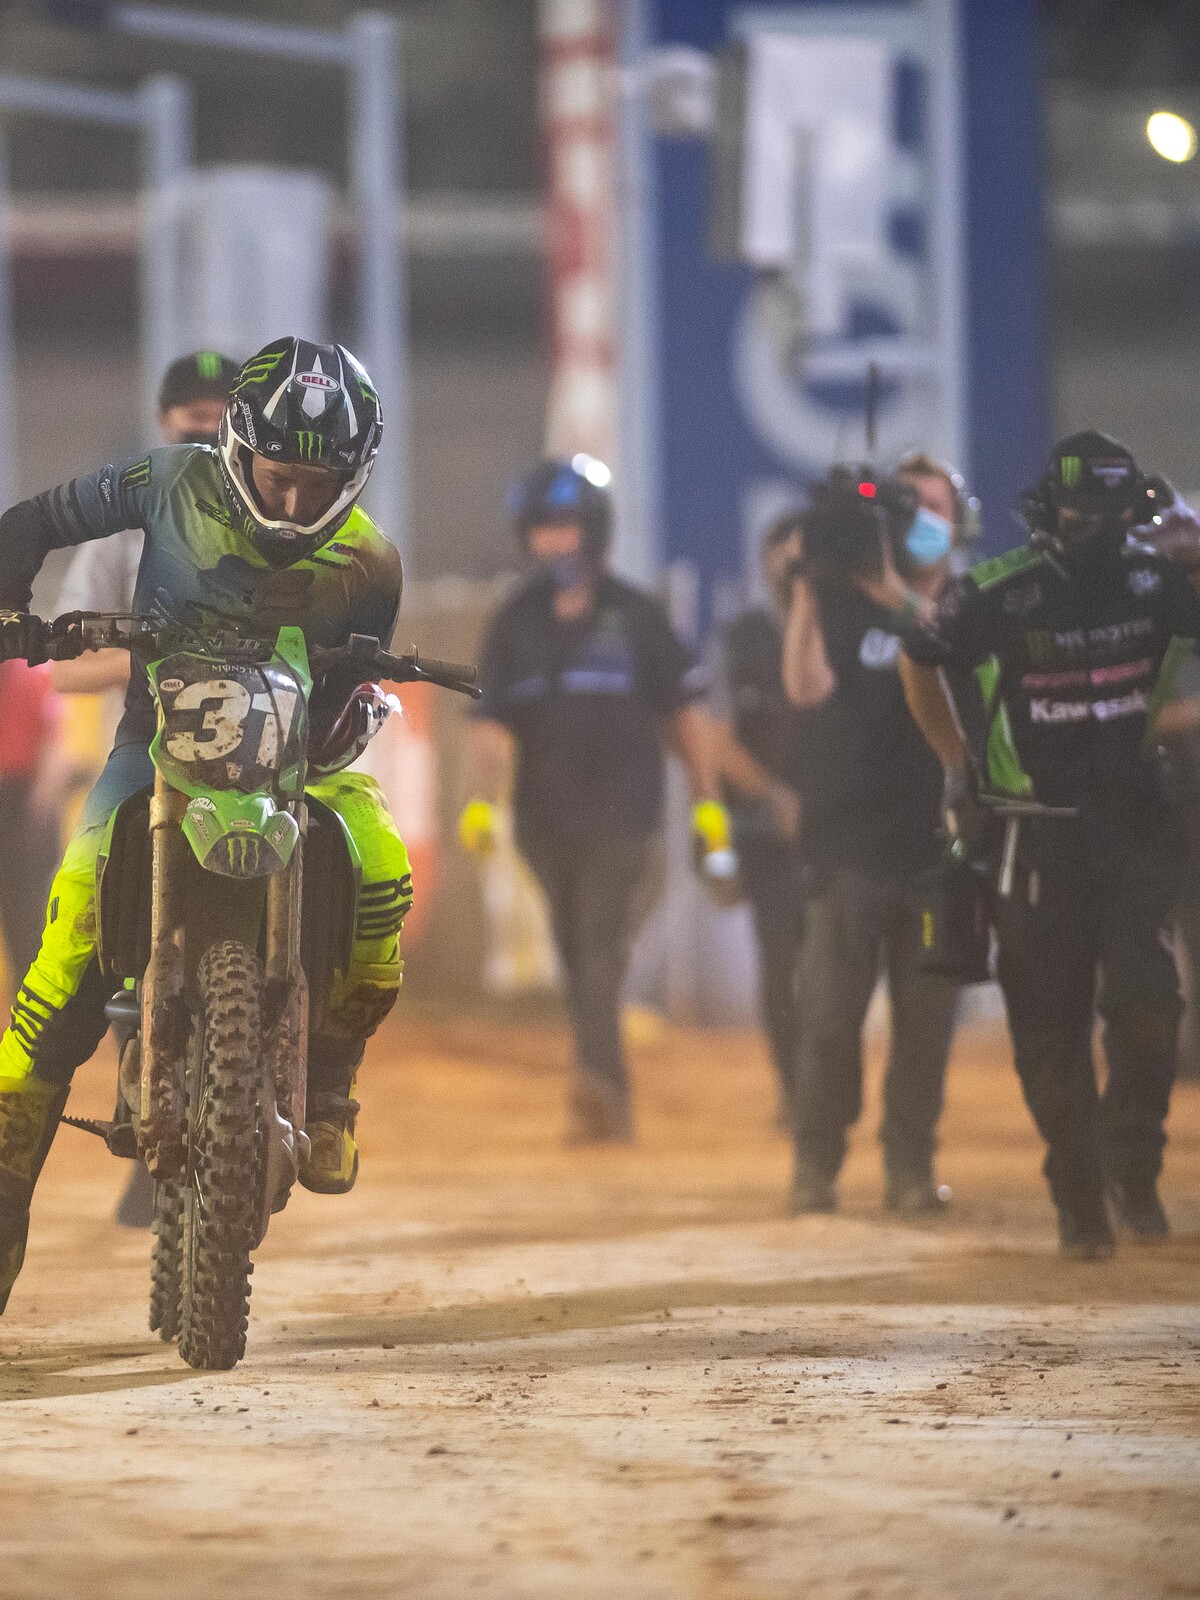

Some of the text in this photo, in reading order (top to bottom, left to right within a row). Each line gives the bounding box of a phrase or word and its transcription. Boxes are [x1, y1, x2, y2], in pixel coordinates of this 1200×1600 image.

[301, 375, 333, 389] BELL
[212, 663, 259, 674] MONST
[1029, 690, 1147, 722] Kawasak
[166, 679, 298, 769] 31
